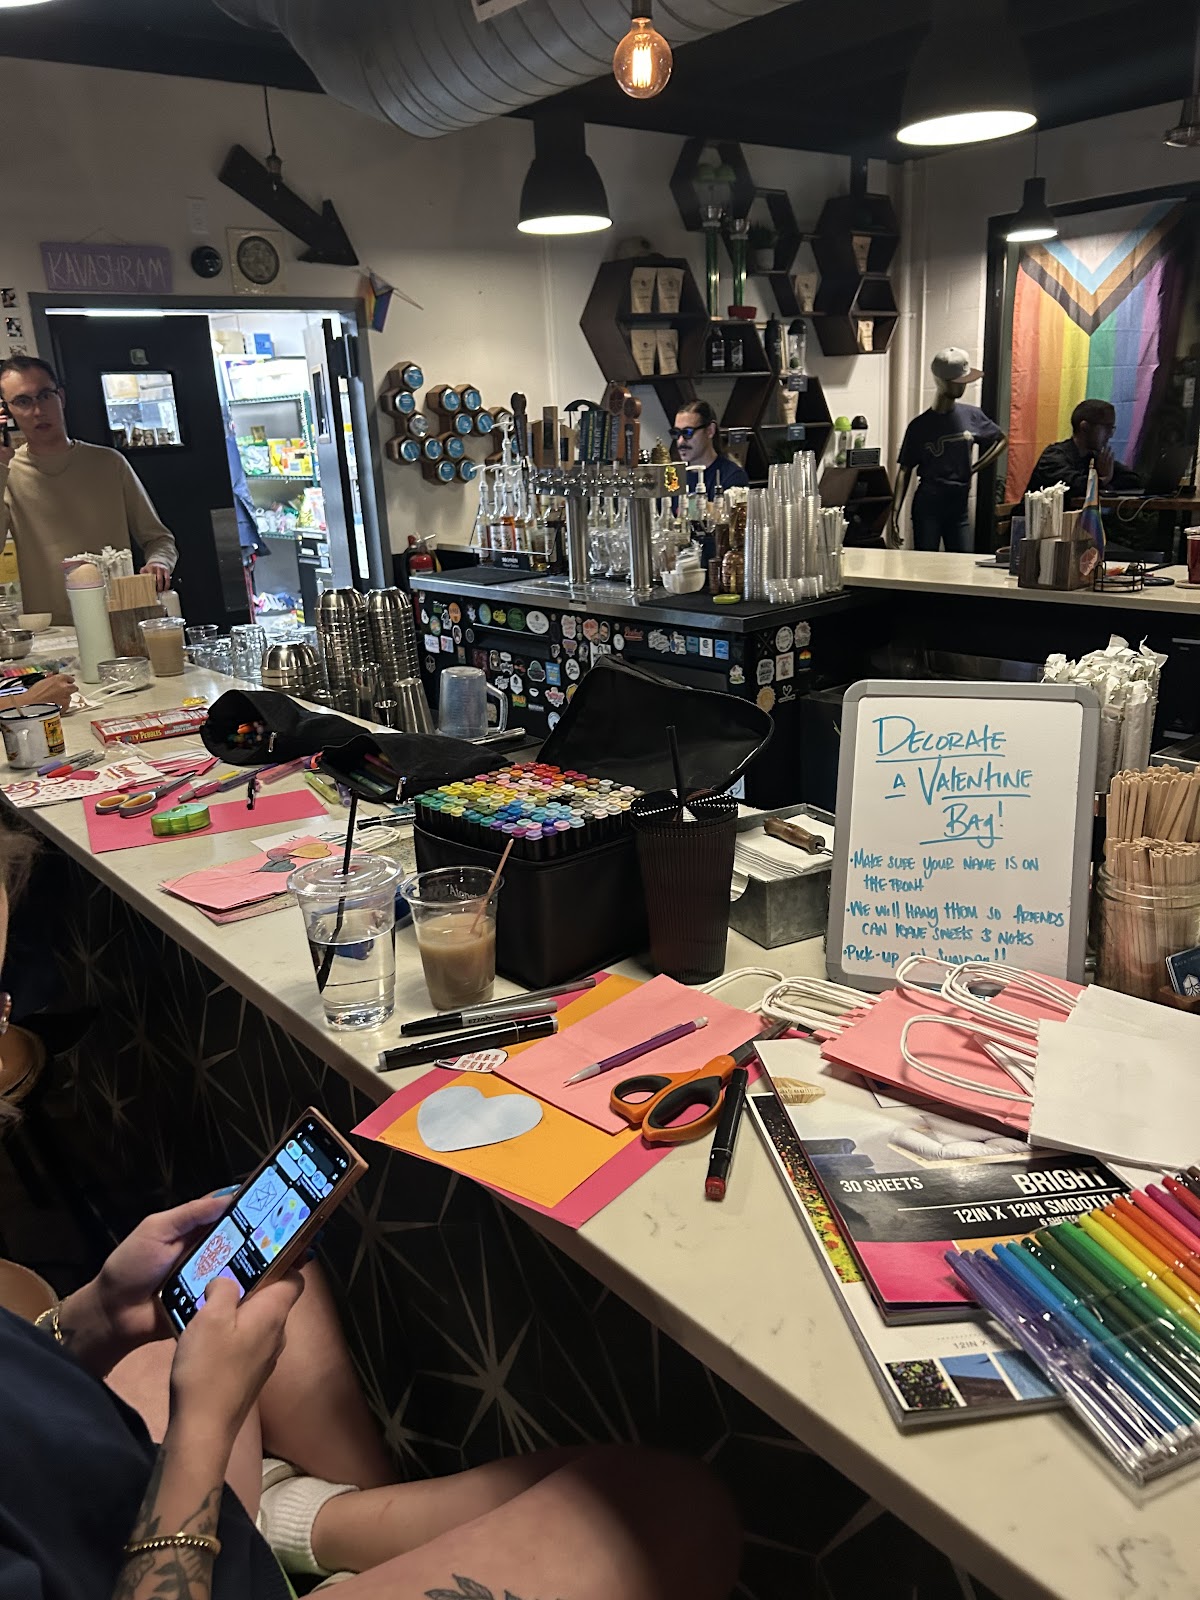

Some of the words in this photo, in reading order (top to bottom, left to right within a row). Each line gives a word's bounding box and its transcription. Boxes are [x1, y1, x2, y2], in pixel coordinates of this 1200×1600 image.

[854, 848, 884, 869] MAKE
[887, 855, 916, 871] SURE
[963, 856, 997, 871] NAME
[1005, 855, 1018, 870] IS
[1022, 857, 1039, 871] ON
[986, 906, 1002, 921] SO
[861, 921, 887, 937] CAN
[839, 1179, 863, 1193] 30
[863, 1176, 924, 1193] SHEETS
[1011, 1167, 1108, 1195] BRIGHT
[953, 1205, 993, 1224] 12IN
[989, 1205, 1008, 1221] X
[1007, 1201, 1046, 1219] 12IN
[1044, 1193, 1115, 1215] SMOOTH
